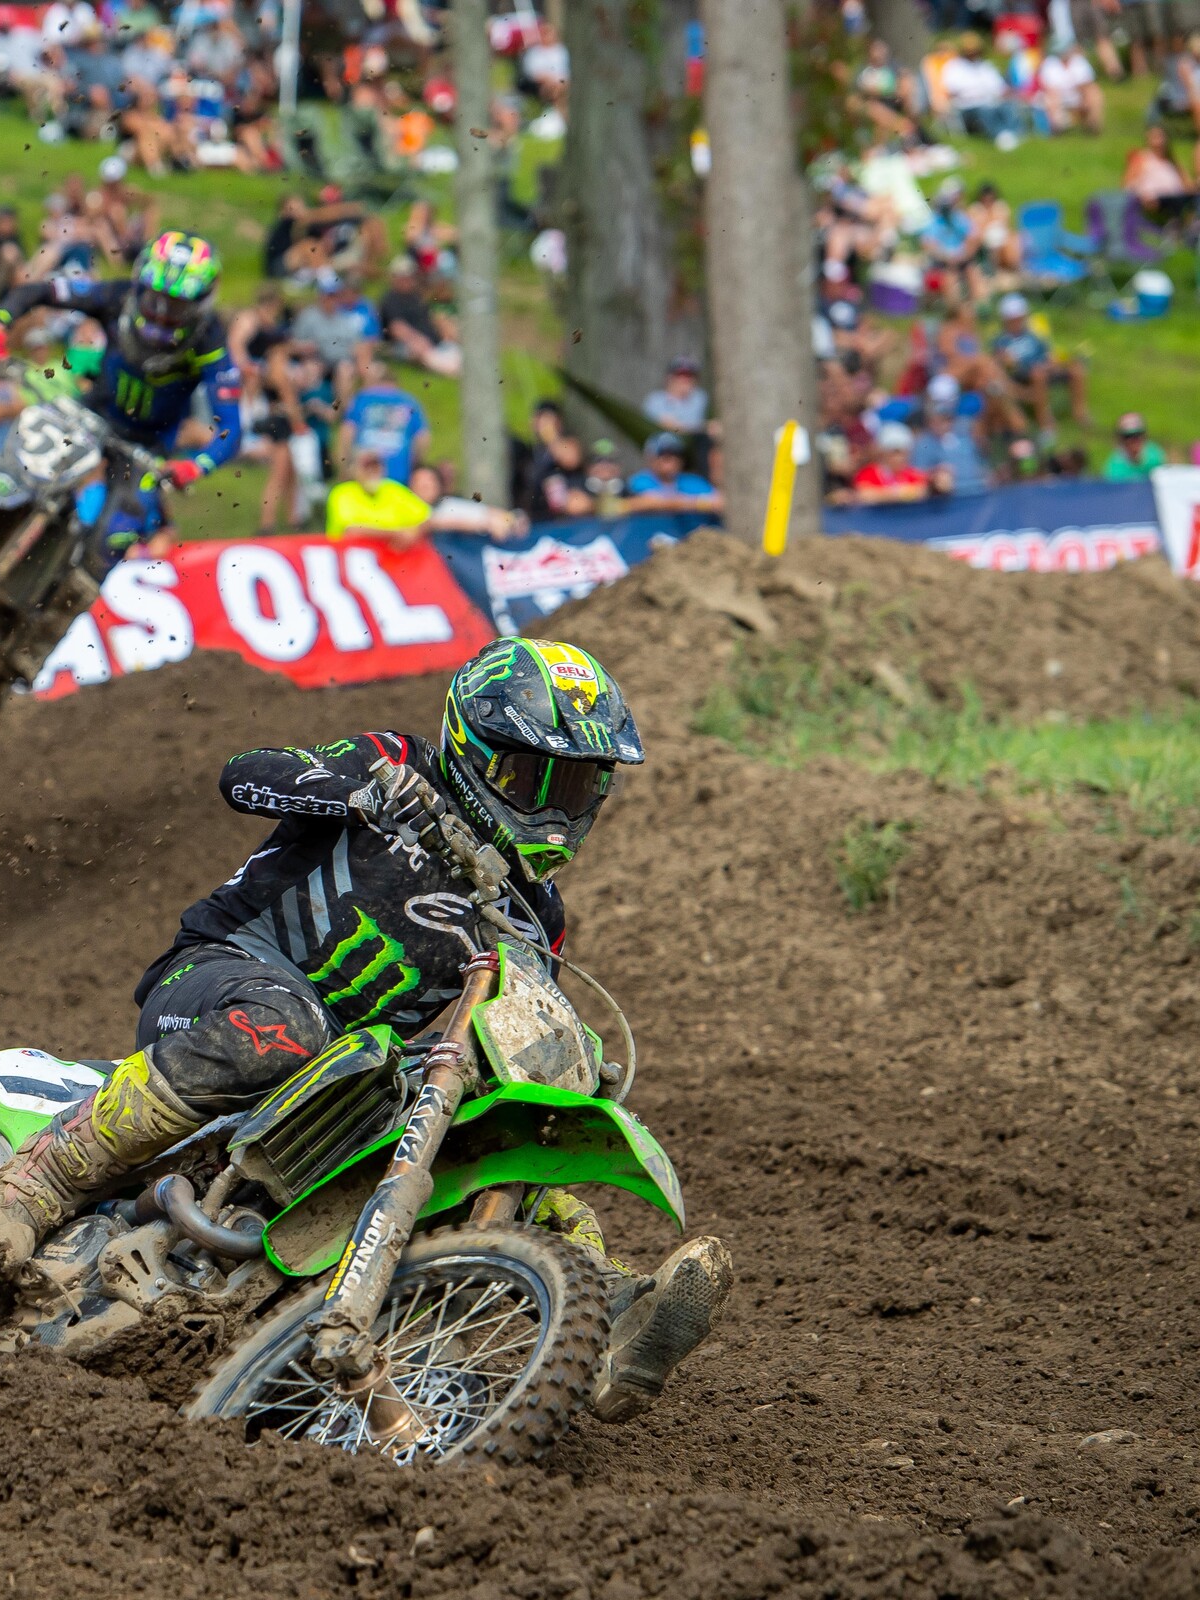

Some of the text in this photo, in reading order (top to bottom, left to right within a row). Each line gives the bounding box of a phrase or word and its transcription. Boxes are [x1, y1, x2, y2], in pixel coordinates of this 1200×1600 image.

[217, 545, 453, 662] OIL
[556, 666, 588, 677] BELL
[232, 782, 348, 817] alpinestars
[448, 760, 494, 828] MONSTER
[545, 982, 577, 1022] LUCA
[156, 1013, 192, 1031] MONSTER
